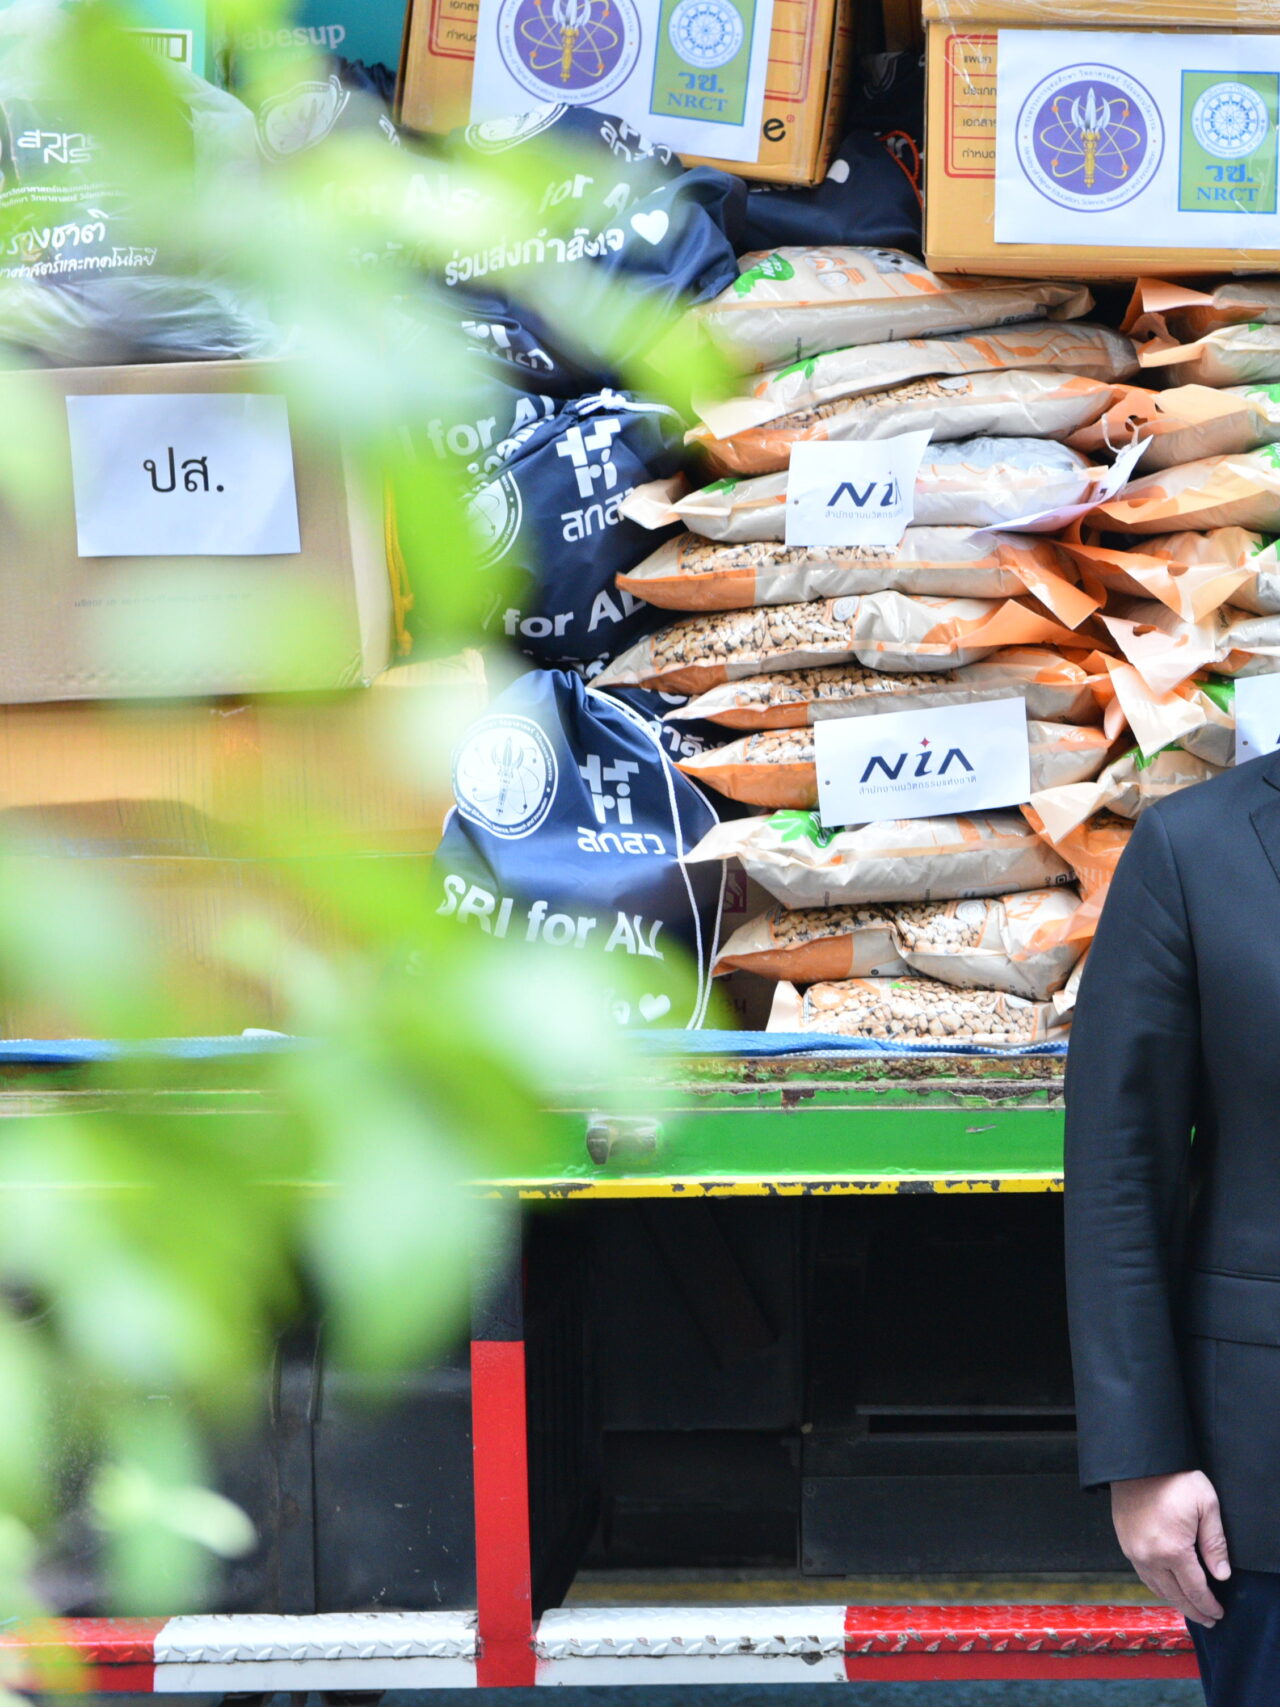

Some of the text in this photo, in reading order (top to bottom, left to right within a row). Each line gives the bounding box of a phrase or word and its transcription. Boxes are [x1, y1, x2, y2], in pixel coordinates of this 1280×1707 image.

[666, 92, 729, 113] NRCT
[1197, 187, 1260, 201] NRCT
[143, 446, 225, 493] ปส.
[502, 607, 574, 638] for
[435, 873, 665, 961] SRI for ALL
